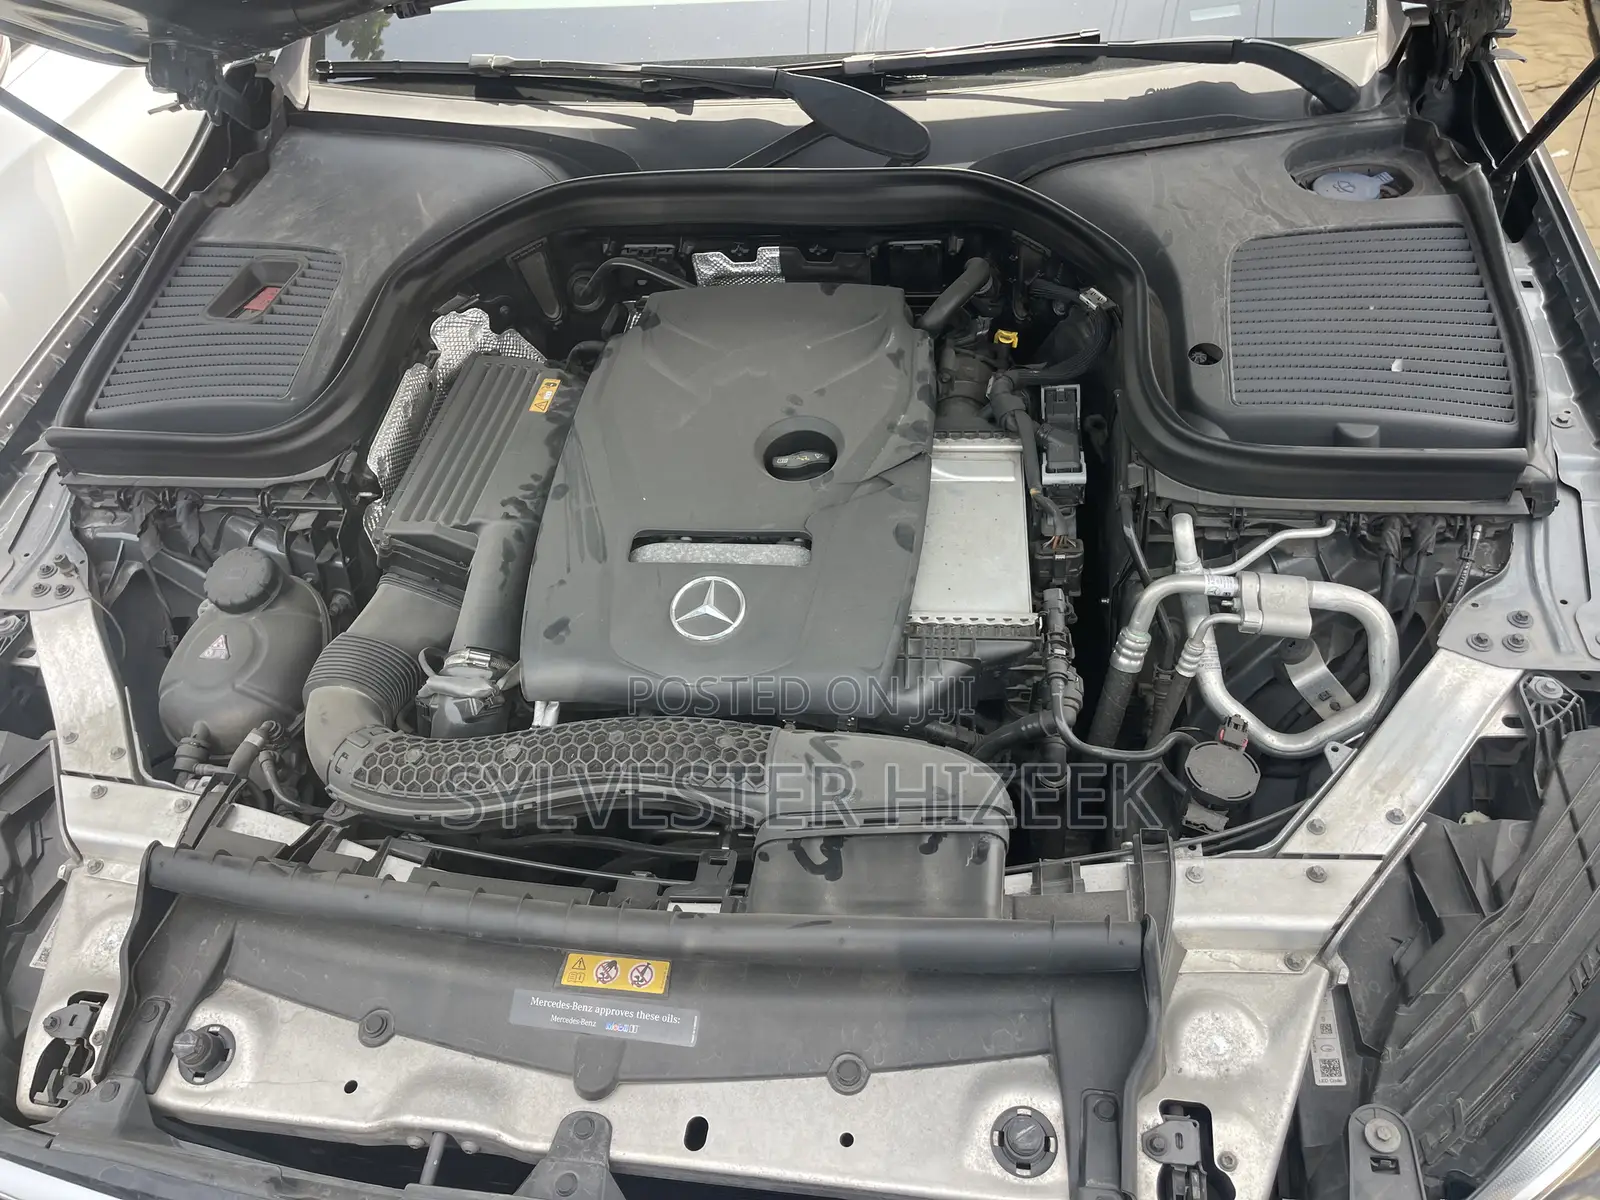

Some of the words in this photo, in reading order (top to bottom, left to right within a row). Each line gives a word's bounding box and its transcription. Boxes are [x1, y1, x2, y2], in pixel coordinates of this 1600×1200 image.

[530, 996, 593, 1013] Mercedes-Benz
[594, 1006, 634, 1018] approves
[636, 1010, 660, 1021] these
[550, 1014, 597, 1028] Mercedes-Benz
